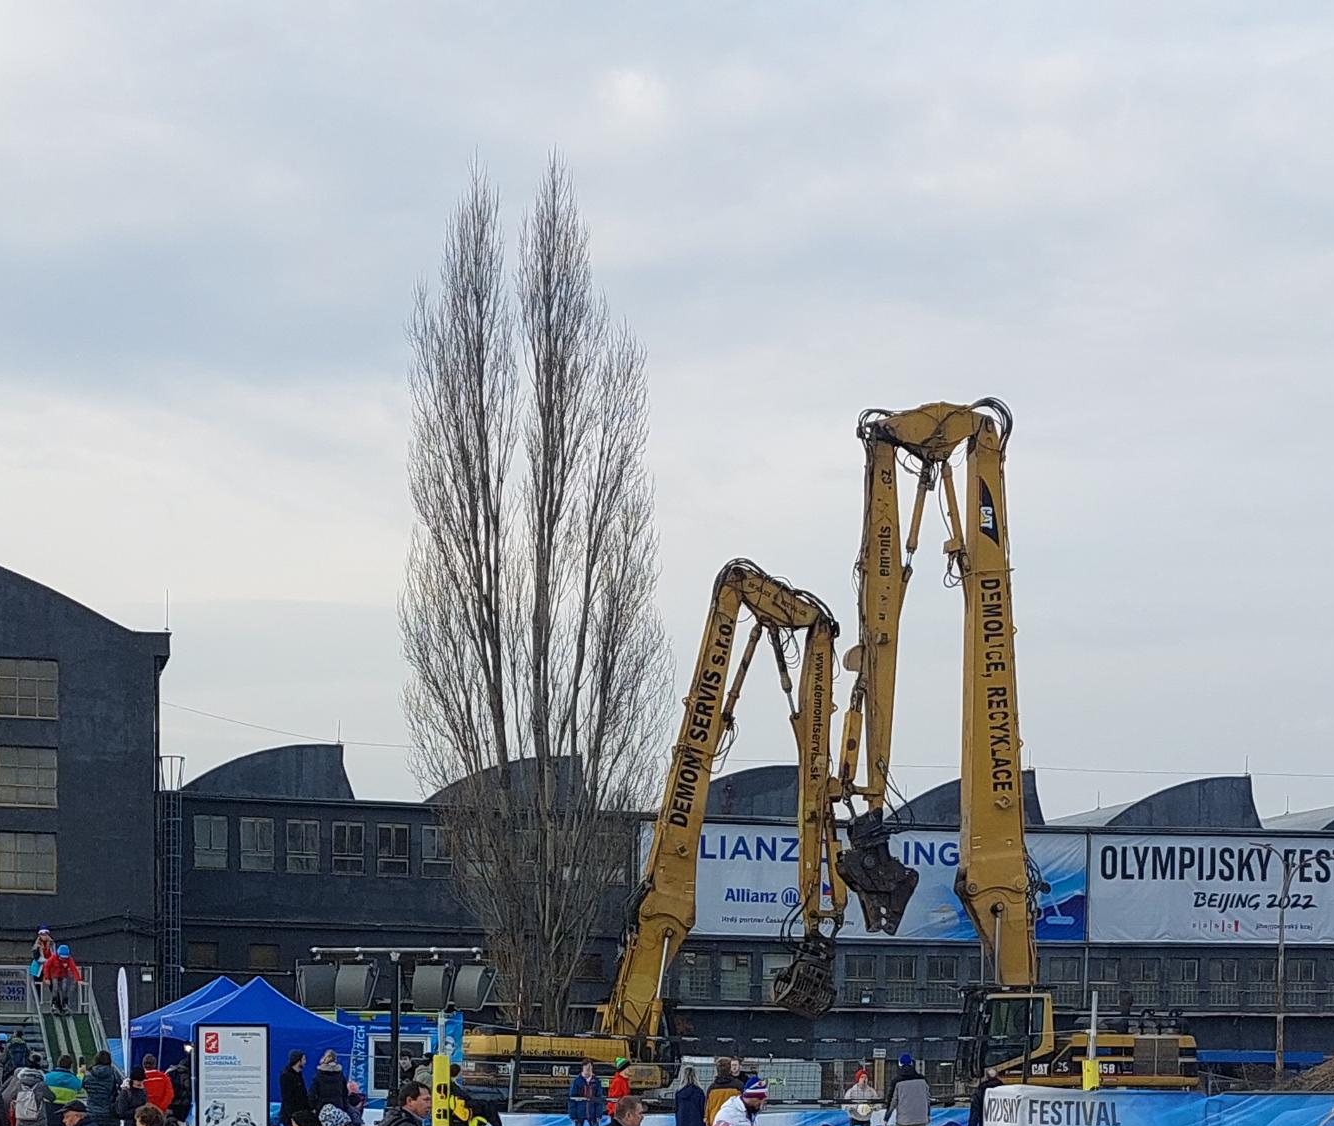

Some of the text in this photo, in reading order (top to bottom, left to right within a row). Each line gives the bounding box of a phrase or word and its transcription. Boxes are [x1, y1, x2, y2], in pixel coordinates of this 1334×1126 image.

[980, 505, 994, 530] CAT
[689, 669, 723, 743] SERVIS
[712, 619, 734, 667] s.r.o.
[700, 834, 961, 866] LIANZ ING
[724, 886, 777, 903] Allianz
[1193, 891, 1317, 912] BEIJING 2022
[552, 1065, 570, 1078] CAT
[1031, 1063, 1050, 1077] CAT
